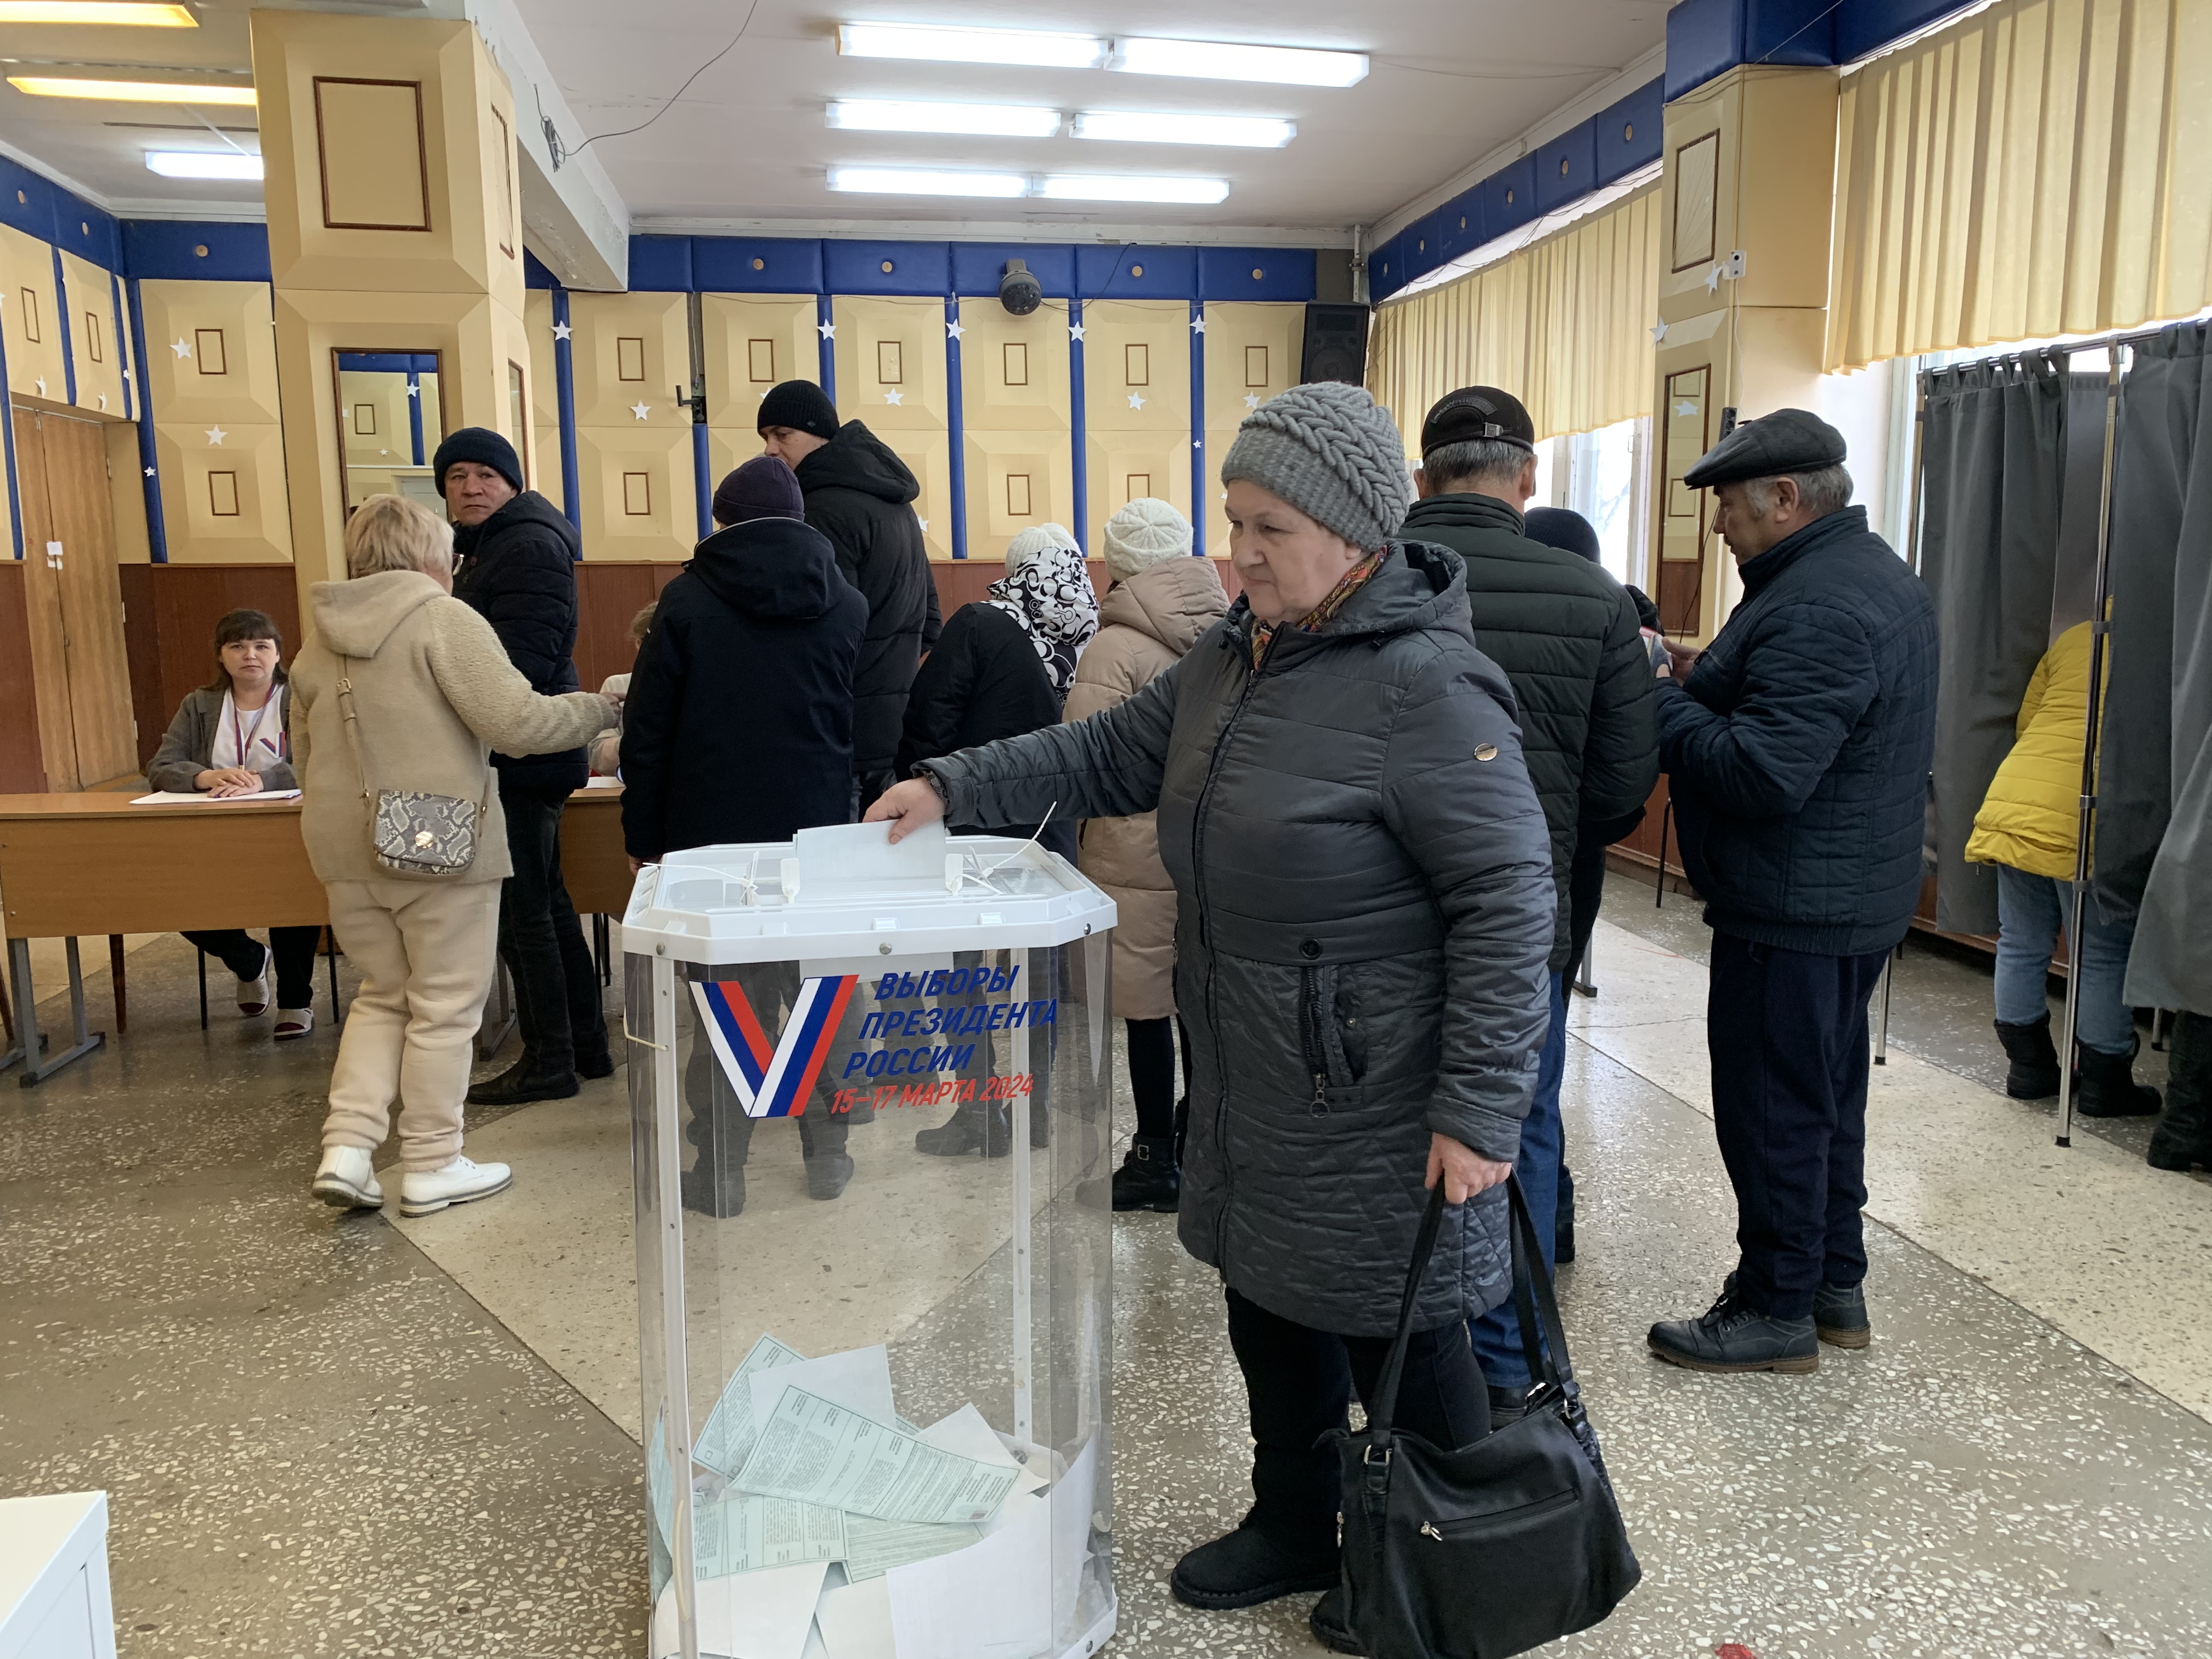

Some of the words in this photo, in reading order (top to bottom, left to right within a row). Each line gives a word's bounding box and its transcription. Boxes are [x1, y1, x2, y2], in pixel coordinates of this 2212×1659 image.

[874, 965, 1020, 1000] ВЫБОРЫ
[858, 998, 1057, 1040] ПРЕЗИДЕНТА
[843, 1043, 976, 1079] РОССИИ
[898, 1079, 977, 1108] МАРТА
[979, 1073, 1034, 1101] 2024
